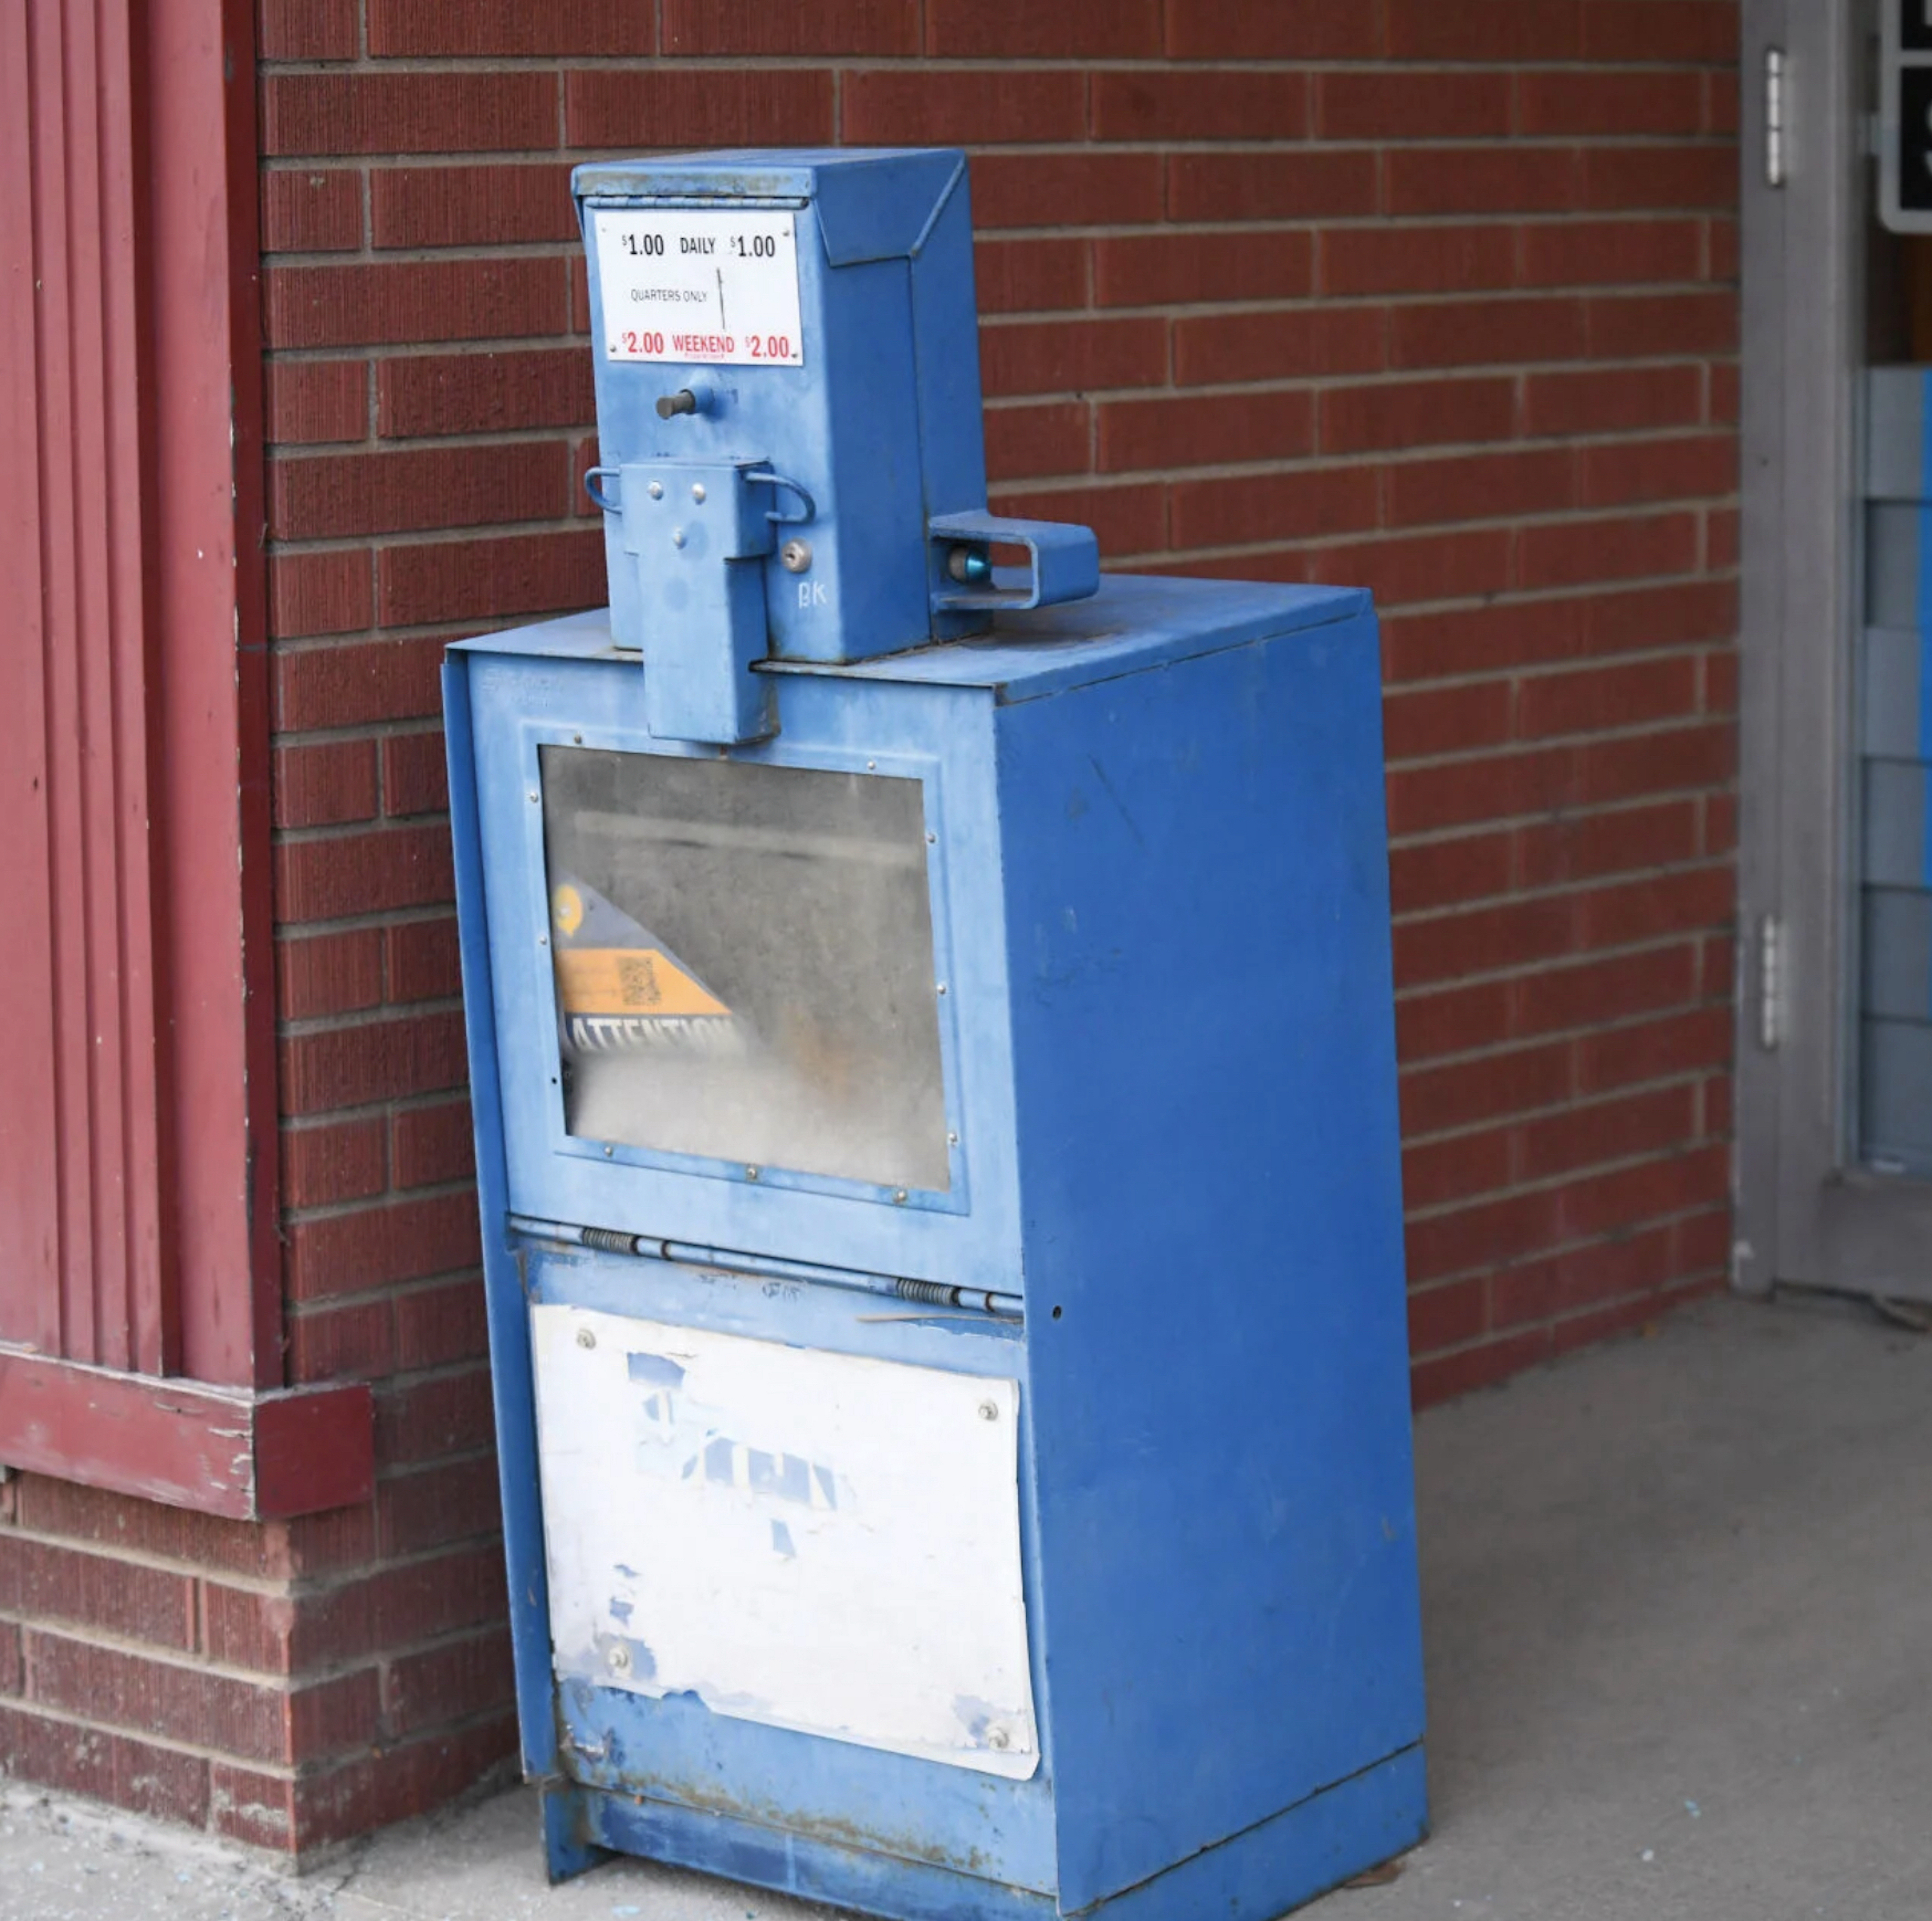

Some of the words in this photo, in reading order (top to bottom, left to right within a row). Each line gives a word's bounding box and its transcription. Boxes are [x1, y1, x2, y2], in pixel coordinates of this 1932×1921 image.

[622, 234, 664, 256] $1.00
[680, 237, 715, 254] DAILY
[730, 235, 775, 257] $1.00
[631, 289, 681, 302] QUARTERS
[683, 290, 707, 302] ONLY
[622, 332, 664, 354] $2.00
[672, 334, 734, 353] WEEKEND
[746, 335, 789, 358] $2.00
